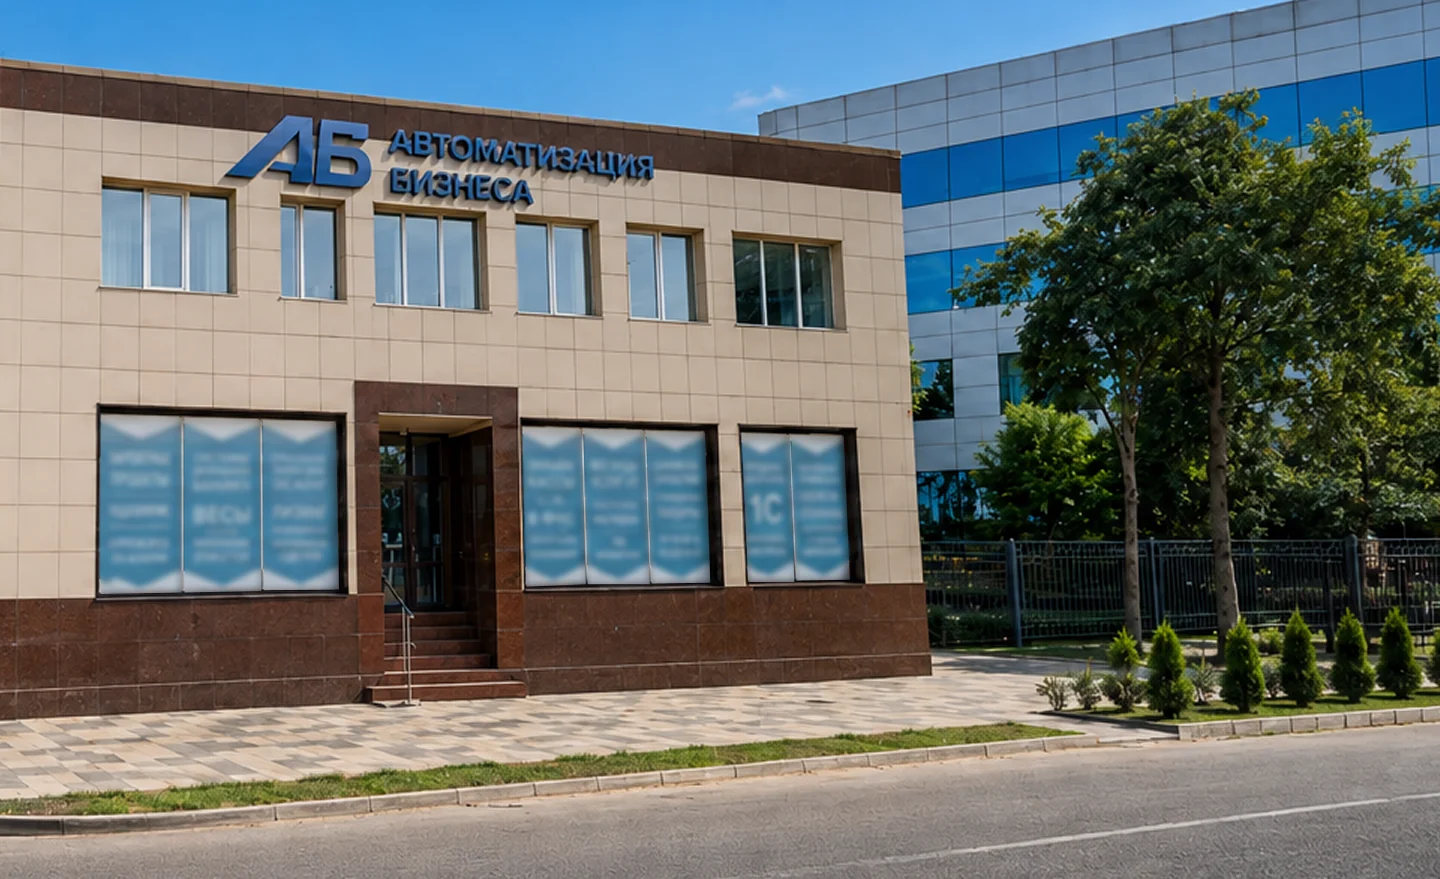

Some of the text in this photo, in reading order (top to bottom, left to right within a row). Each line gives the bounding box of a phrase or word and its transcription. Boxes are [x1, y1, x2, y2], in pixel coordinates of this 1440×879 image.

[225, 114, 372, 188] АБ
[388, 129, 655, 180] АВТОМАТИЗАЦИЯ
[390, 167, 534, 204] БИЗНЕСА
